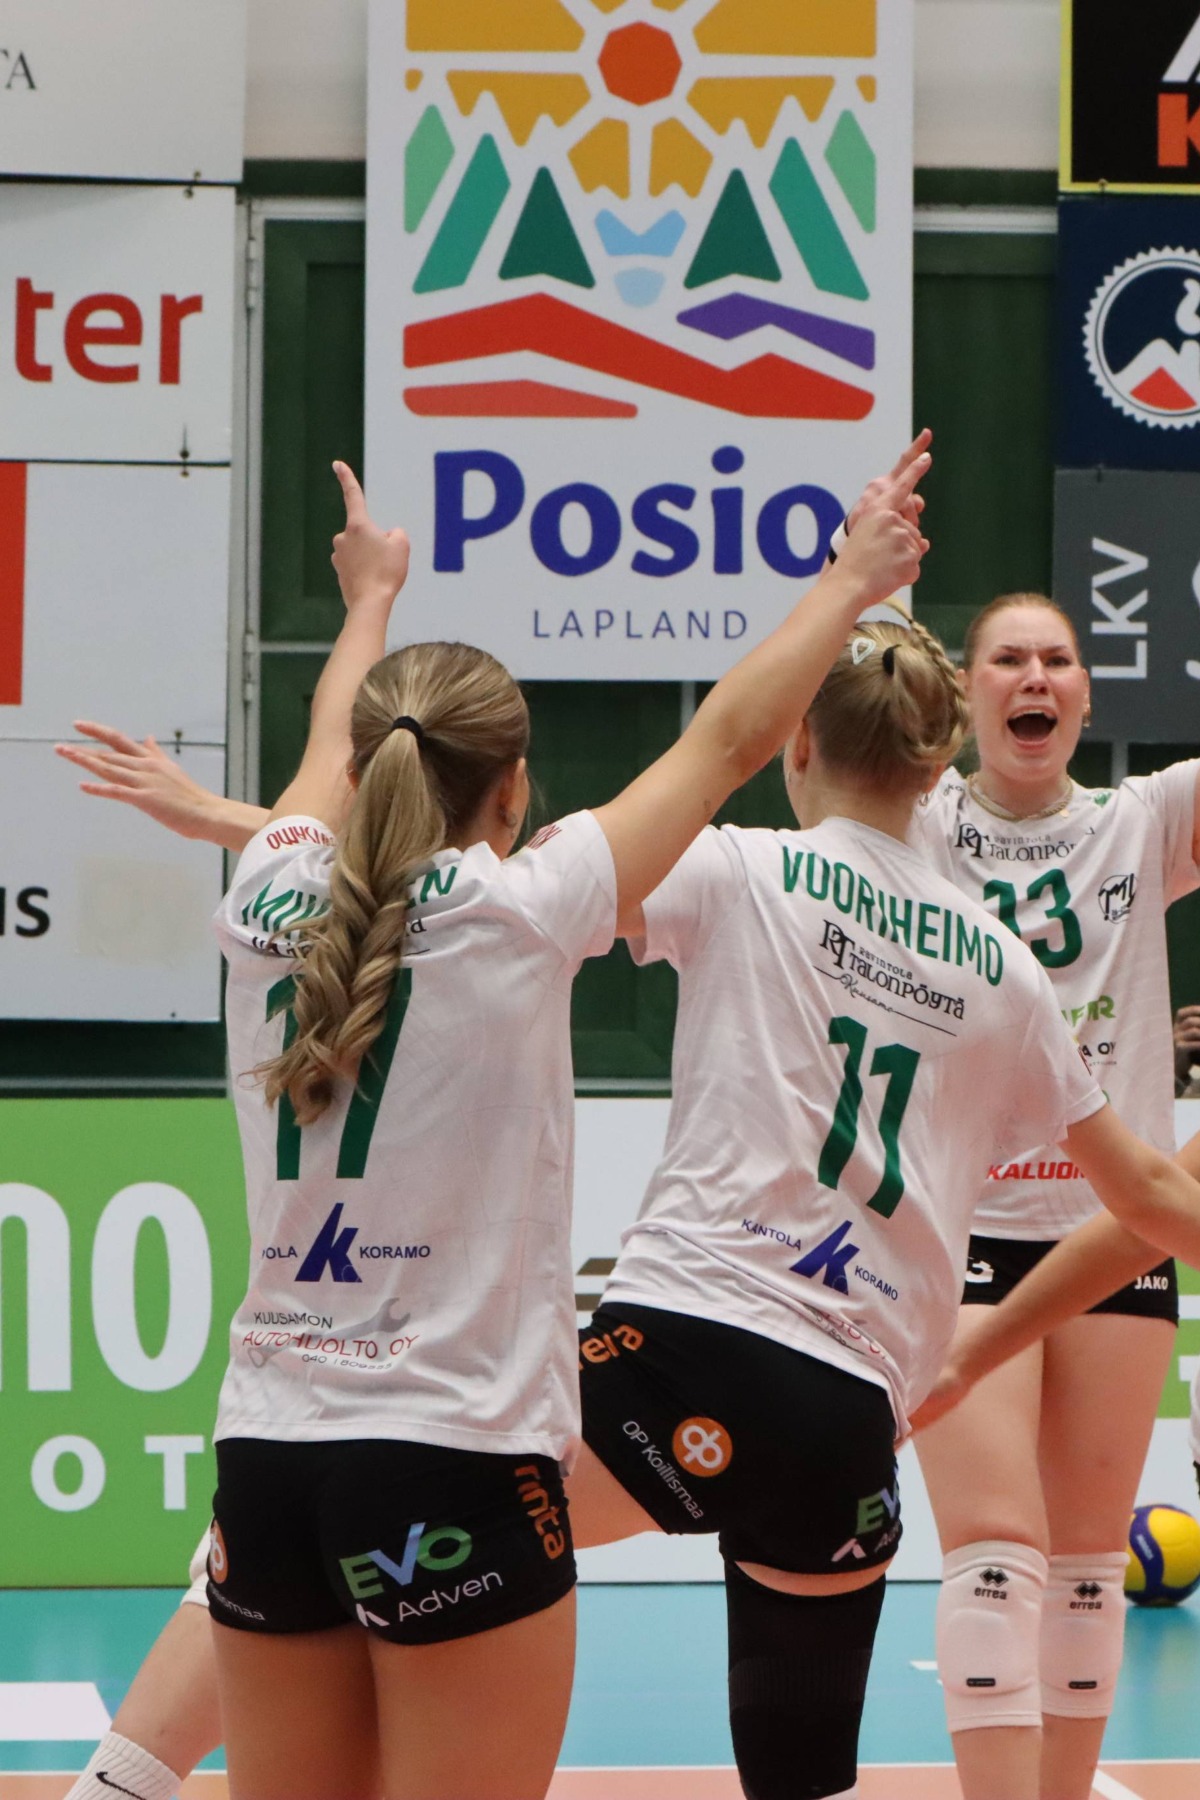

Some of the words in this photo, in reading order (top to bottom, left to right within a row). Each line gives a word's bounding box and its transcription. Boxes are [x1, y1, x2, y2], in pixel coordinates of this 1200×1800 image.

[0, 49, 38, 91] A
[14, 276, 204, 386] ter
[433, 445, 846, 578] Posio
[533, 609, 748, 640] LAPLAND
[1090, 538, 1149, 680] LKV
[782, 845, 1004, 987] VUORIHEIMO
[818, 1015, 921, 1220] 11
[262, 1246, 298, 1260] OLA
[359, 1245, 431, 1259] KORAMO
[741, 1218, 802, 1252] KANTOLA
[853, 1264, 899, 1302] KORAMO
[1134, 1275, 1169, 1291] JAKO
[242, 1331, 379, 1360] AUTOHUOLTO
[389, 1334, 420, 1356] OY
[253, 1311, 334, 1330] KUUSAMON
[301, 1353, 328, 1364] 040
[622, 1420, 650, 1444] OP
[641, 1444, 705, 1520] Koillismaa
[338, 1521, 473, 1600] EVO
[398, 1571, 504, 1623] Adven
